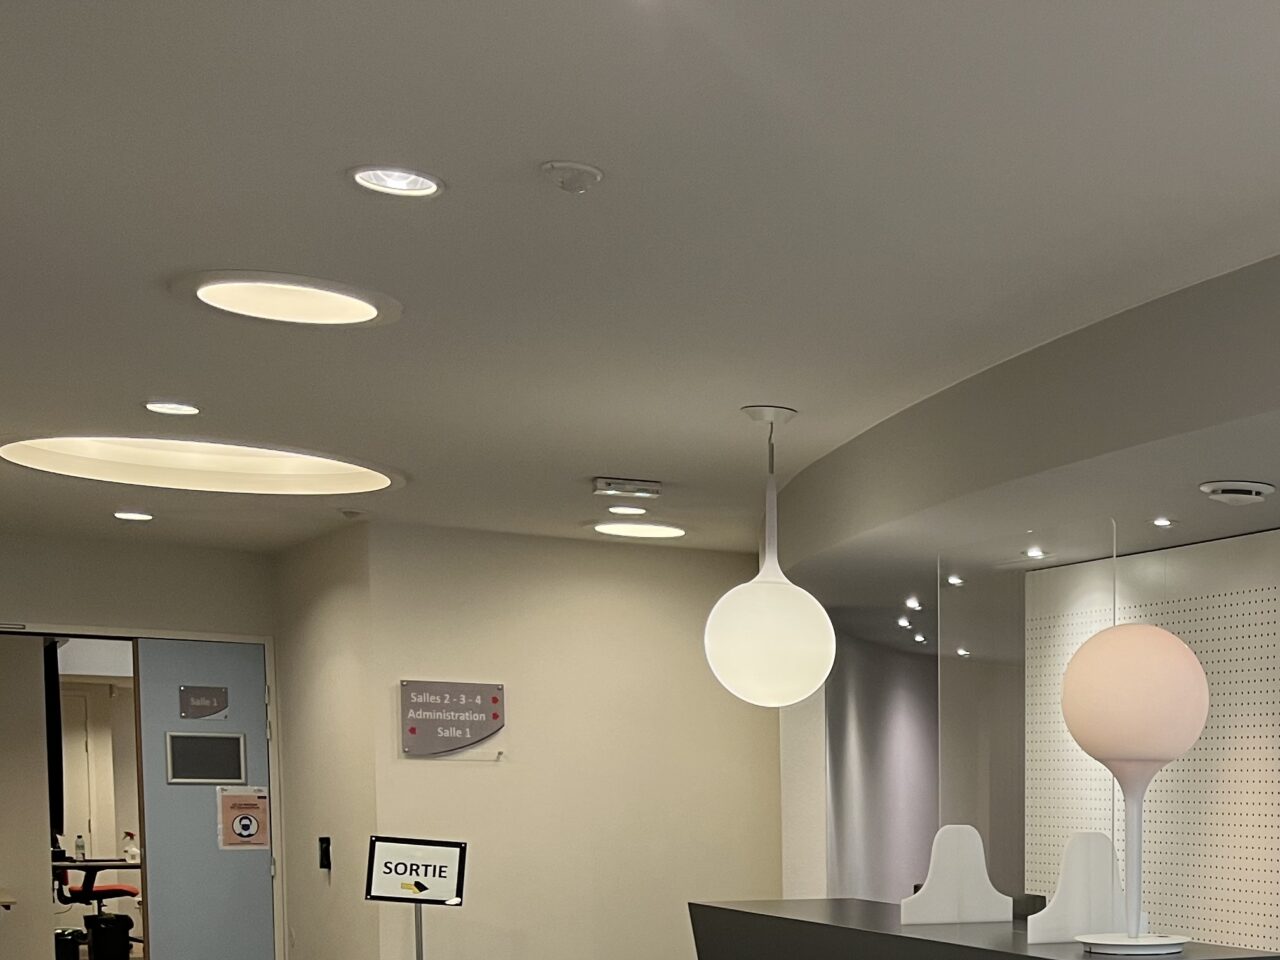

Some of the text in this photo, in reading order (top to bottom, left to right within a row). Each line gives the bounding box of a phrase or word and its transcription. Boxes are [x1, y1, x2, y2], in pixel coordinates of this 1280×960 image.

[410, 692, 441, 704] Salles
[443, 693, 450, 704] 2
[459, 694, 466, 704] 3
[475, 695, 482, 705] 4
[407, 708, 486, 721] Administration
[437, 727, 471, 738] Salle 1
[383, 861, 448, 879] SORTIE
